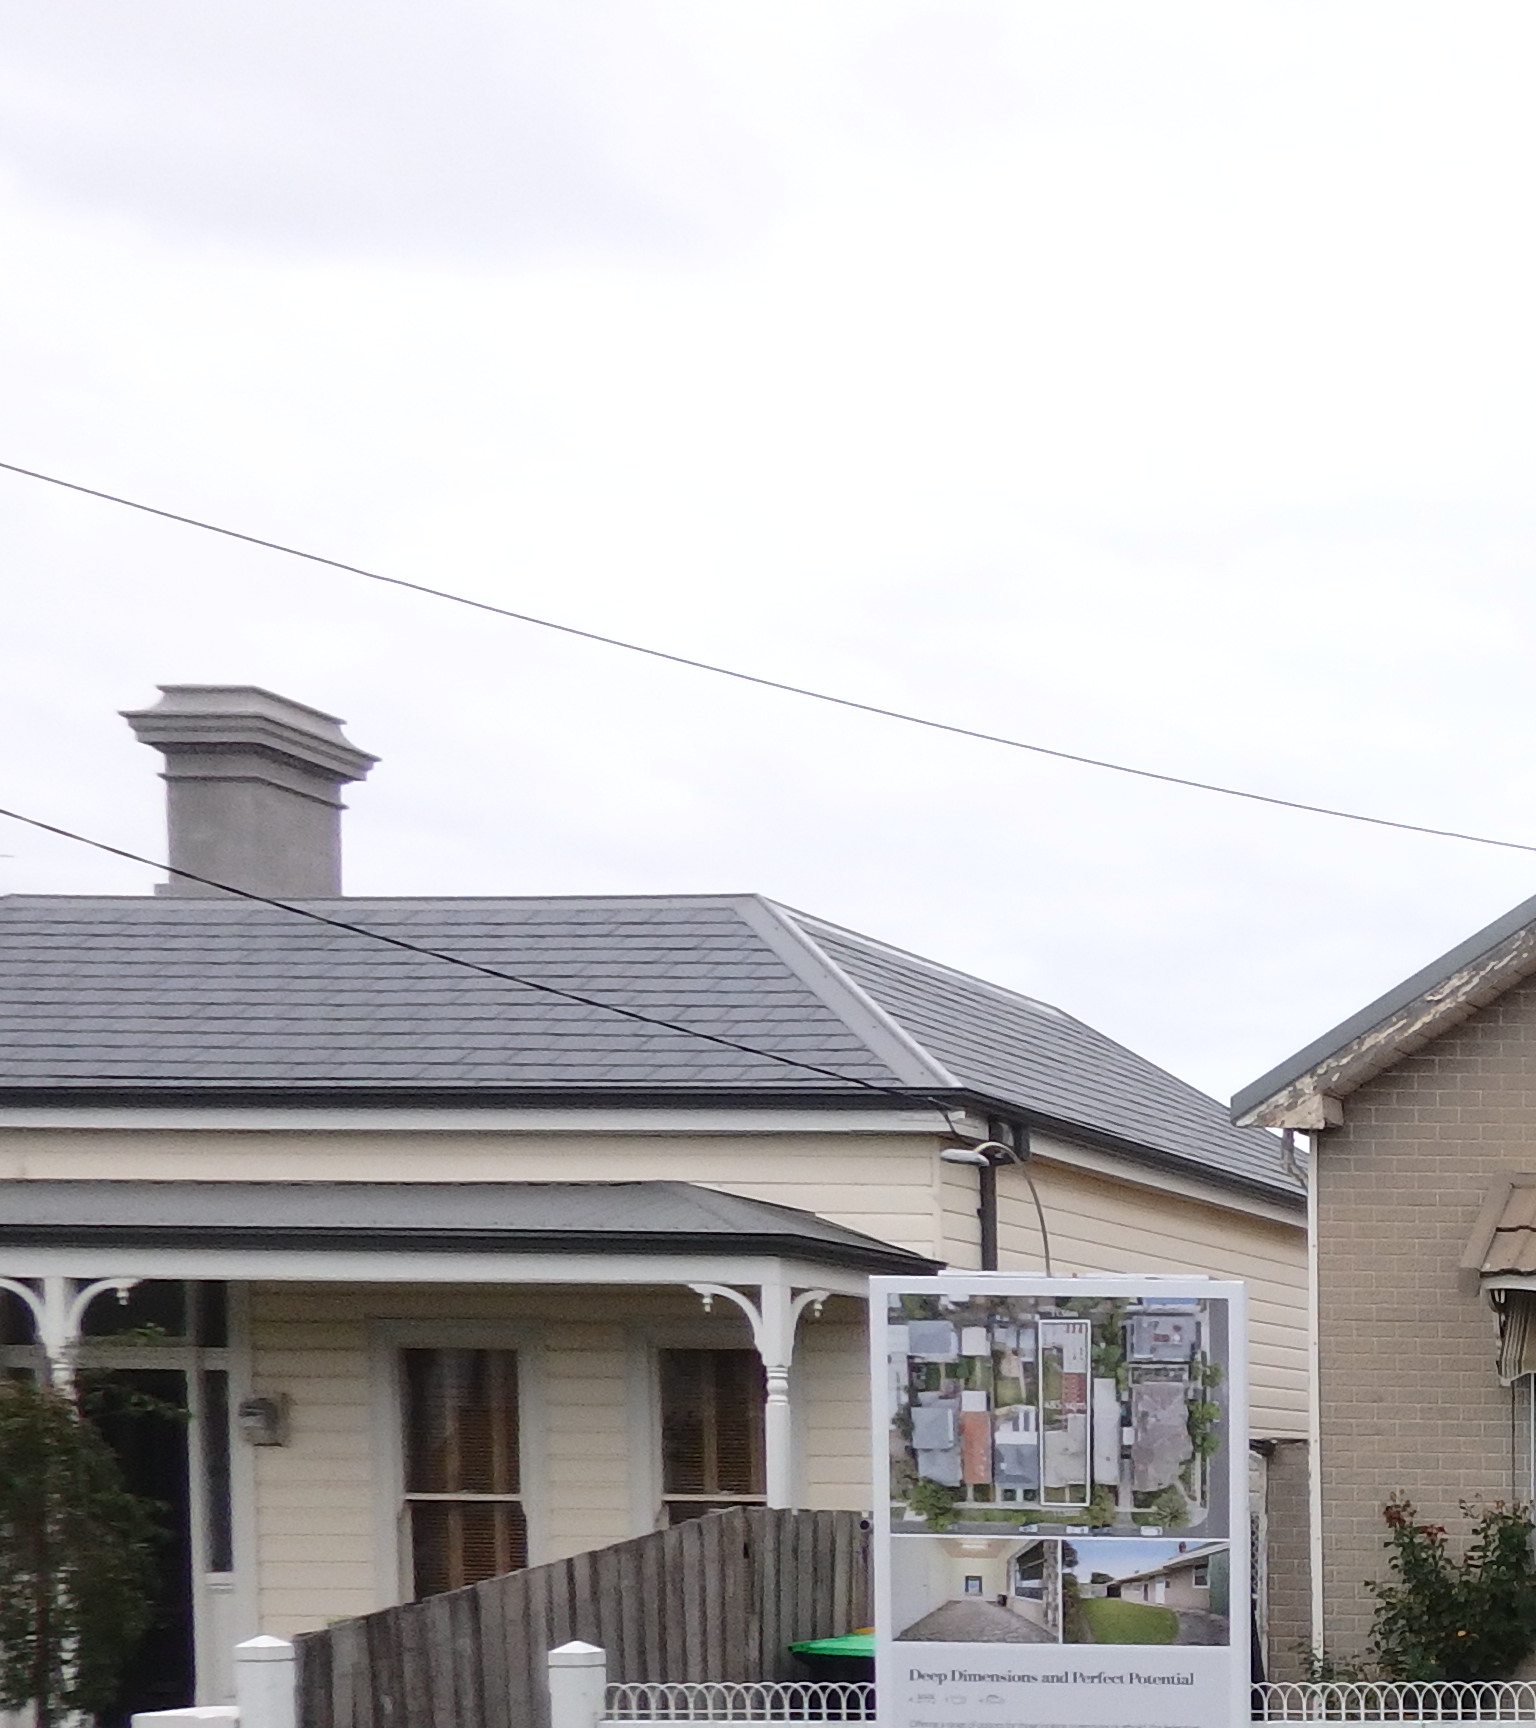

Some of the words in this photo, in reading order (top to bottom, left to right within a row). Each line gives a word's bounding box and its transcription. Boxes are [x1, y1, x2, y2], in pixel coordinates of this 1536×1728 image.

[909, 1668, 948, 1685] Deep
[951, 1669, 1038, 1683] Dimensions
[1041, 1671, 1068, 1684] and
[1073, 1671, 1124, 1685] Perfect
[1129, 1672, 1194, 1686] Potential
